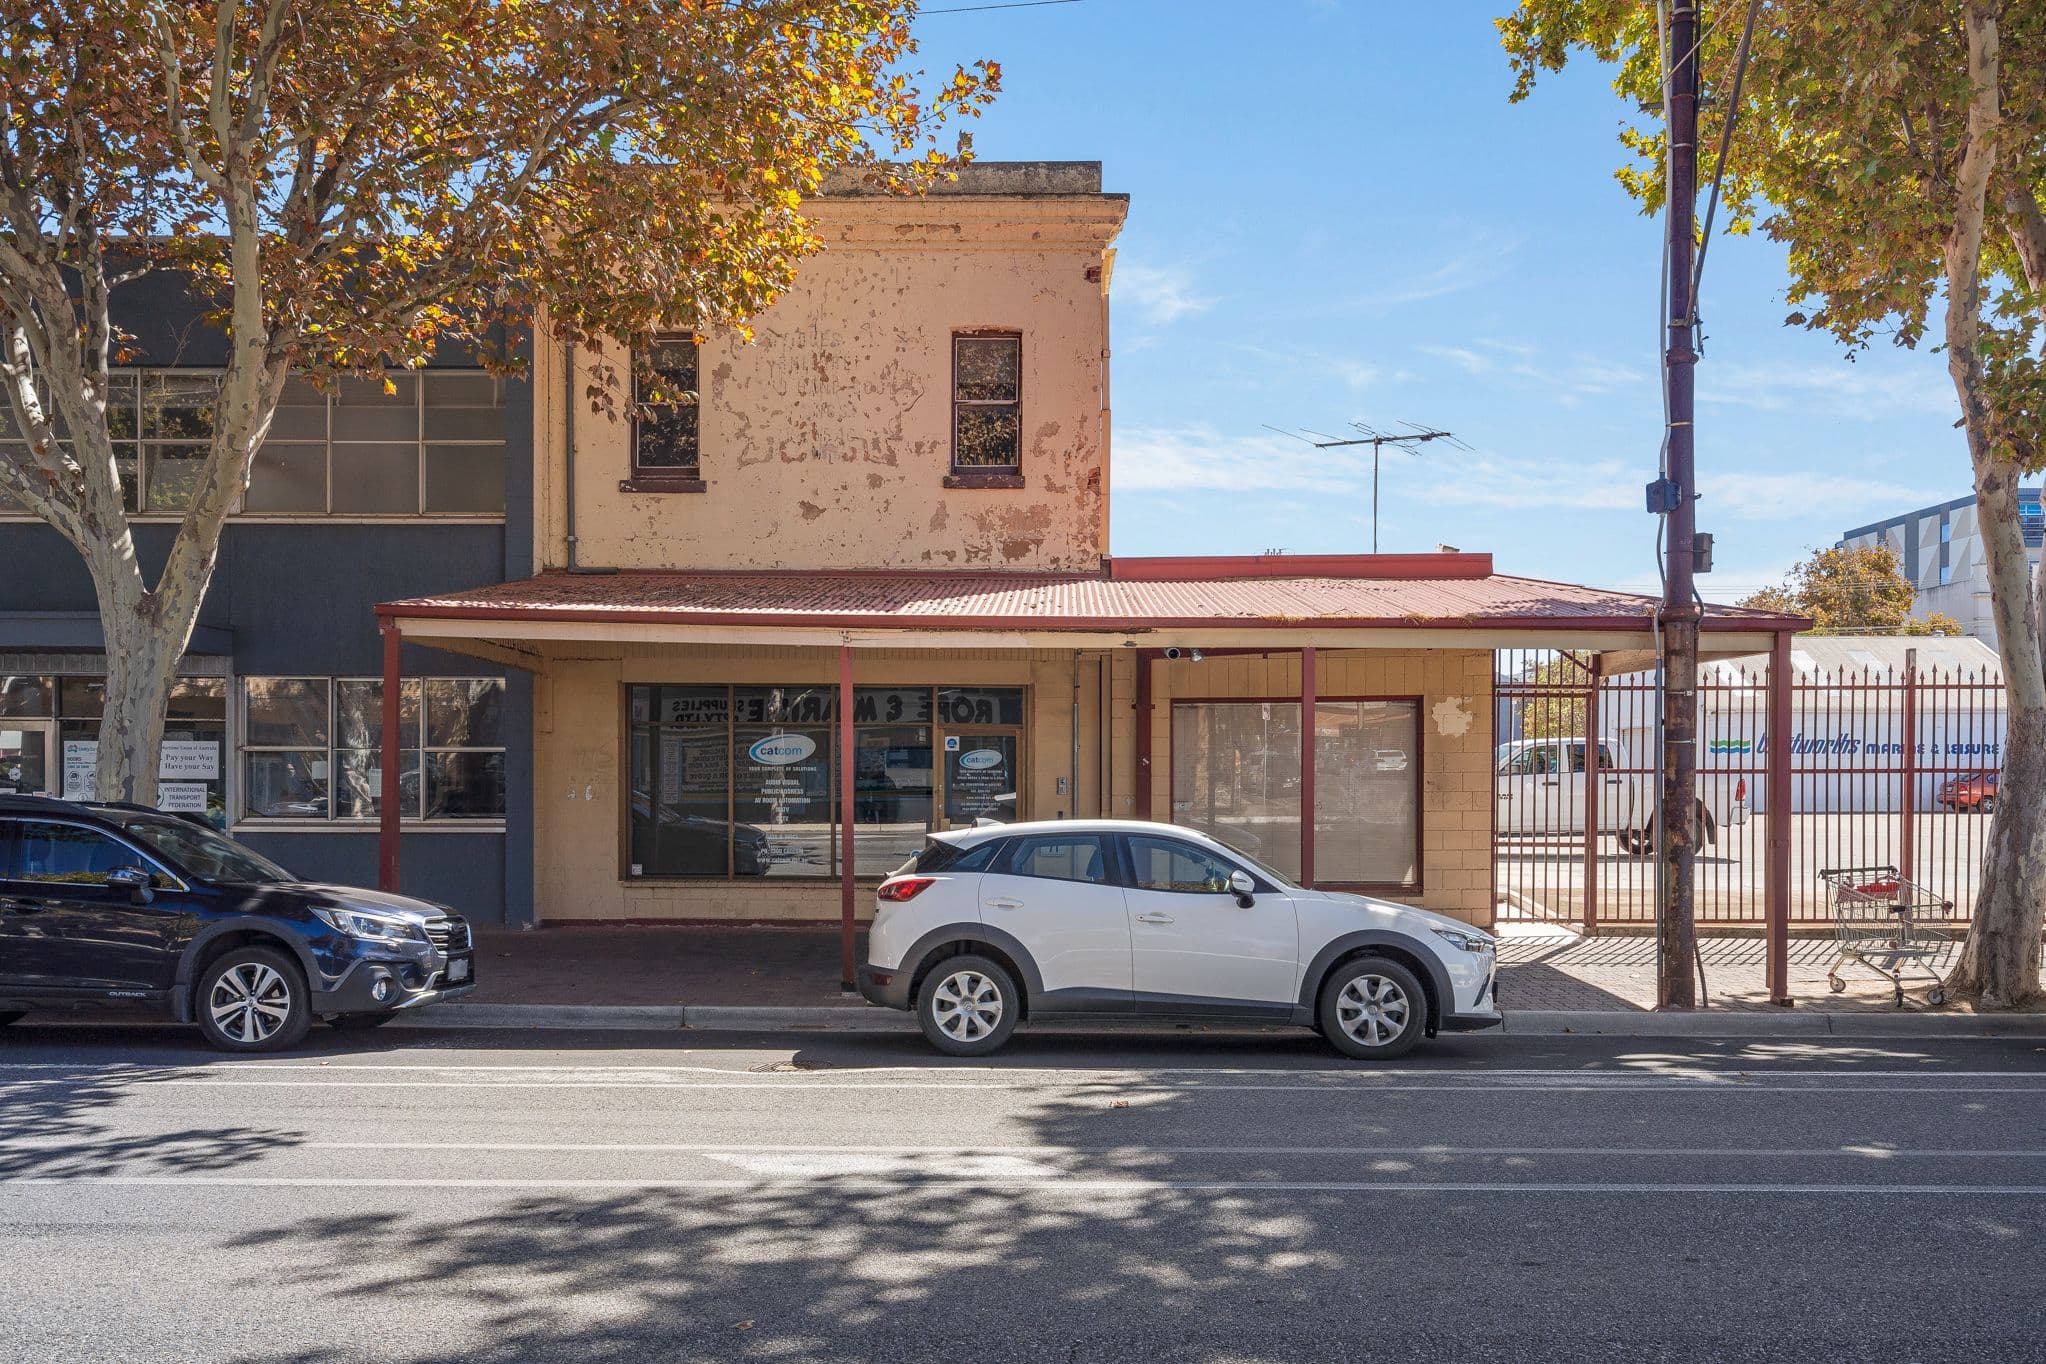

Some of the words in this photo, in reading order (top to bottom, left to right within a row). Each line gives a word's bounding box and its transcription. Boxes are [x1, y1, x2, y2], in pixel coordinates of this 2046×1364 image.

[760, 746, 802, 755] catcom
[1866, 743, 1925, 754] MARE
[166, 754, 178, 762] Pay
[198, 754, 213, 762] Way
[202, 763, 214, 771] Say
